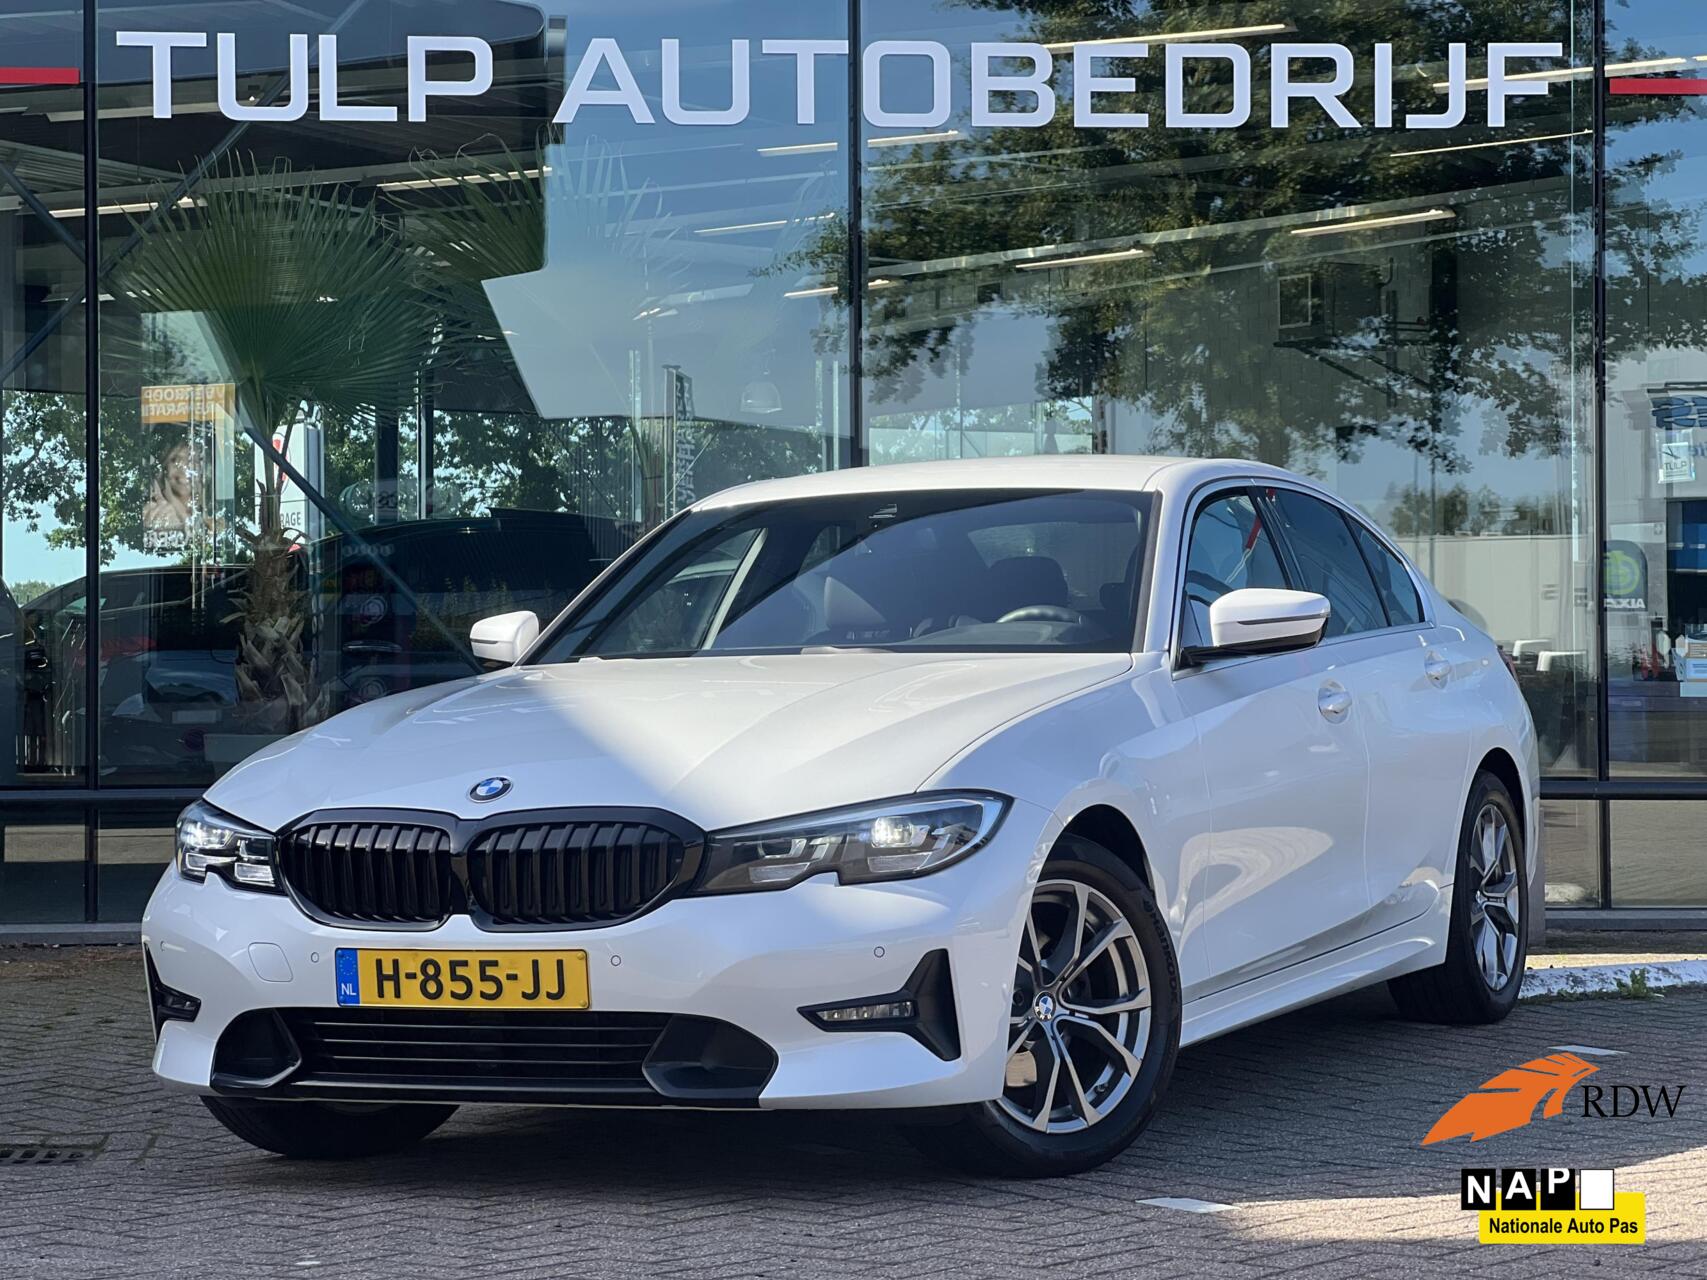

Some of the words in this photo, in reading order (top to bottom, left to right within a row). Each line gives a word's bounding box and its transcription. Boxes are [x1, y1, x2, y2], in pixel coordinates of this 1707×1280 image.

[116, 31, 494, 122] TULP
[552, 38, 1563, 129] AUTOBEDRIJF
[341, 982, 357, 996] NL
[375, 958, 566, 1001] H-855-JJ
